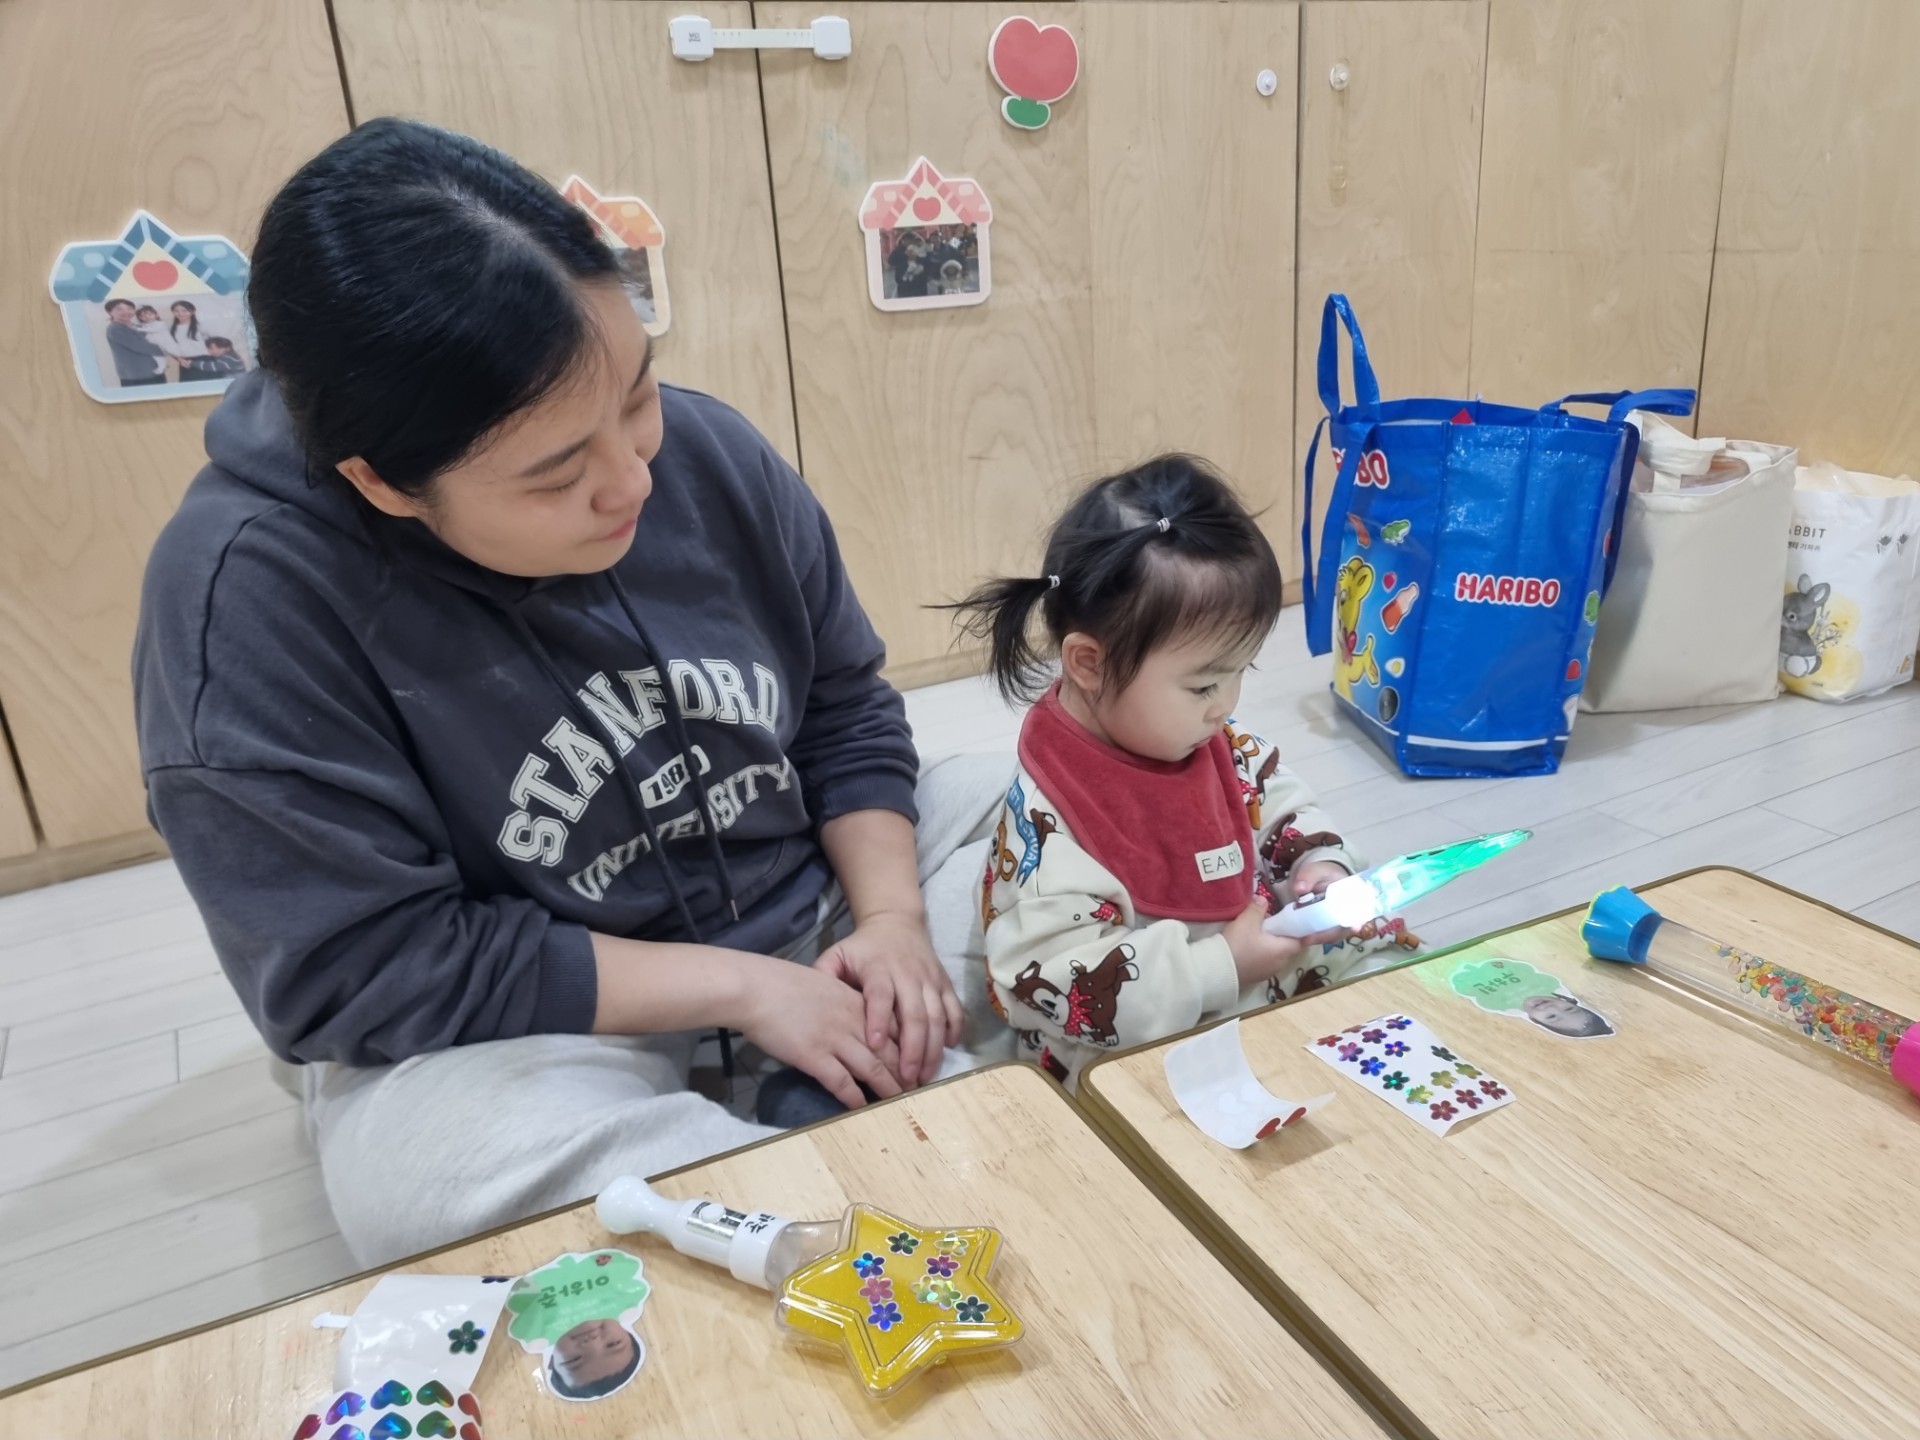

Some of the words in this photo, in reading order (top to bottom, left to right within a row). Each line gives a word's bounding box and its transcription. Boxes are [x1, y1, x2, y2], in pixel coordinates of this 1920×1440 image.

[1789, 525, 1827, 539] BBIT
[1456, 572, 1560, 606] HARIBO
[496, 658, 780, 867] STANFORD
[537, 1275, 611, 1309] 이하준
